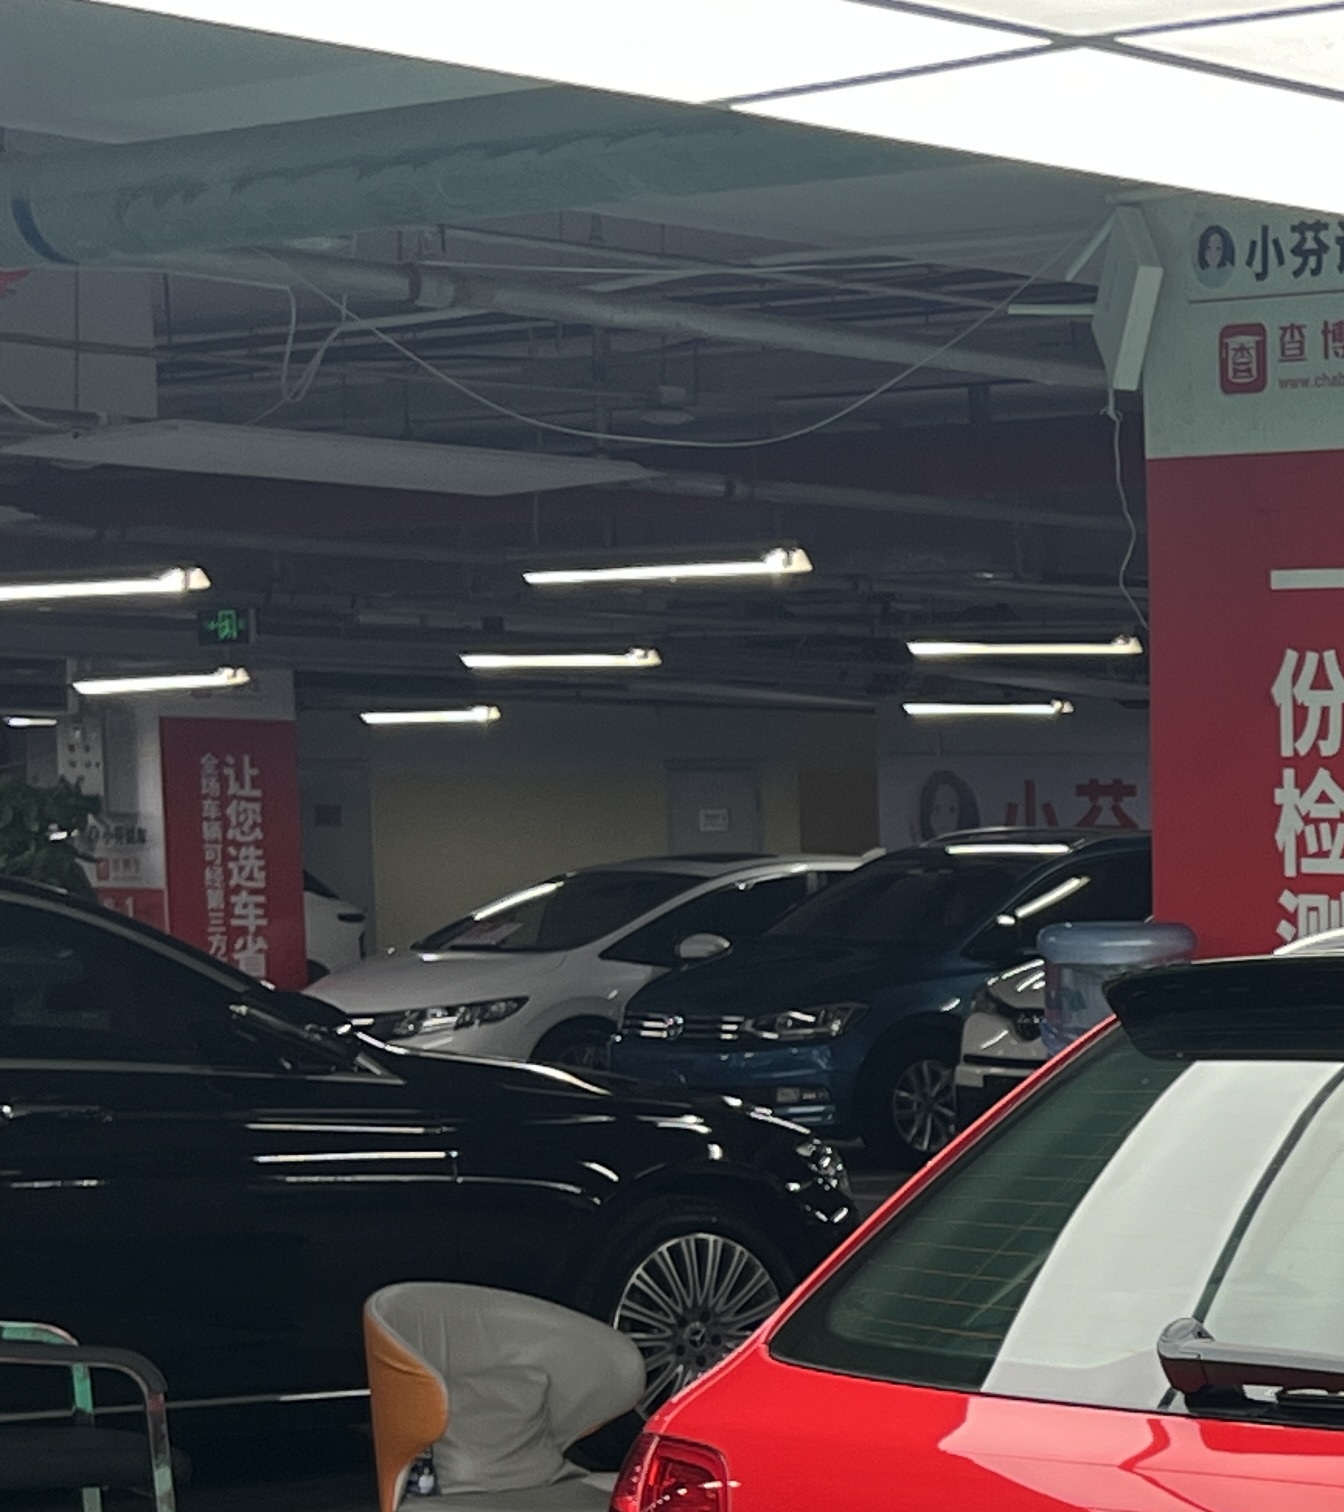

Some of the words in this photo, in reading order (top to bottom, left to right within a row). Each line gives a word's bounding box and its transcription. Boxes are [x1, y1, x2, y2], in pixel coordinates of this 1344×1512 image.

[200, 753, 228, 962] 全场车辆可经第三方
[222, 753, 268, 978] 让您选车省
